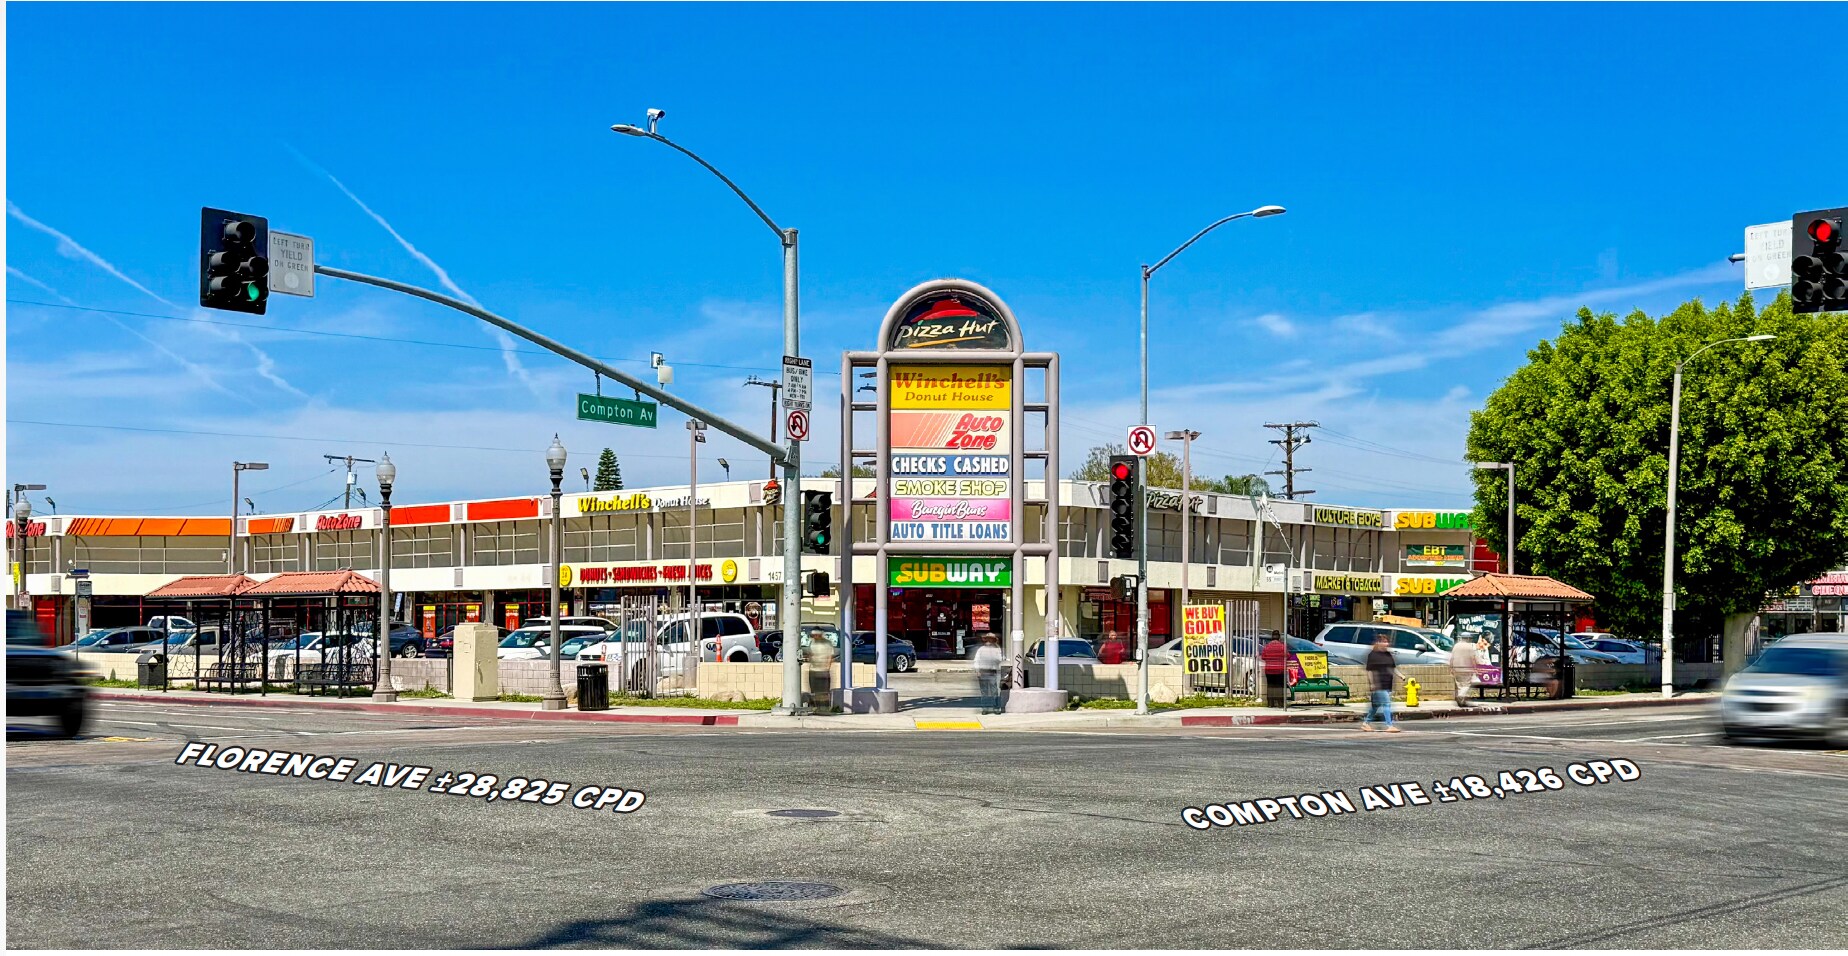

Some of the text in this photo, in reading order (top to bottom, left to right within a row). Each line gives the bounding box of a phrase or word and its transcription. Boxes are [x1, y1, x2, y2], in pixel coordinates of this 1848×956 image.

[273, 237, 310, 250] LEFT TURN
[280, 248, 302, 261] YIELD
[274, 259, 309, 271] ON GREEN
[894, 318, 1001, 346] Pizza Hut
[895, 372, 1006, 389] Winchell's
[905, 391, 994, 402] Donut House
[581, 400, 653, 421] Compton Av
[956, 413, 1003, 432] Auto
[945, 431, 996, 450] Zone
[892, 456, 1009, 474] CHECKS CASHED
[895, 480, 1007, 496] SMOKE SHOP
[578, 493, 652, 512] Winchell's
[315, 513, 362, 530] AutoZone
[1315, 508, 1382, 527] KULTURE BOYS
[1394, 511, 1469, 529] SUBWA
[892, 523, 1008, 538] AUTO TITLE LOANS
[1423, 545, 1447, 555] EBT
[768, 571, 782, 581] 1457
[896, 562, 1006, 583] SUBWAY
[1314, 575, 1345, 590] MARKET
[1185, 607, 1219, 619] WE BUY
[1185, 620, 1222, 634] GOLD
[1186, 645, 1224, 658] COMPRO
[1188, 659, 1223, 672] ORO
